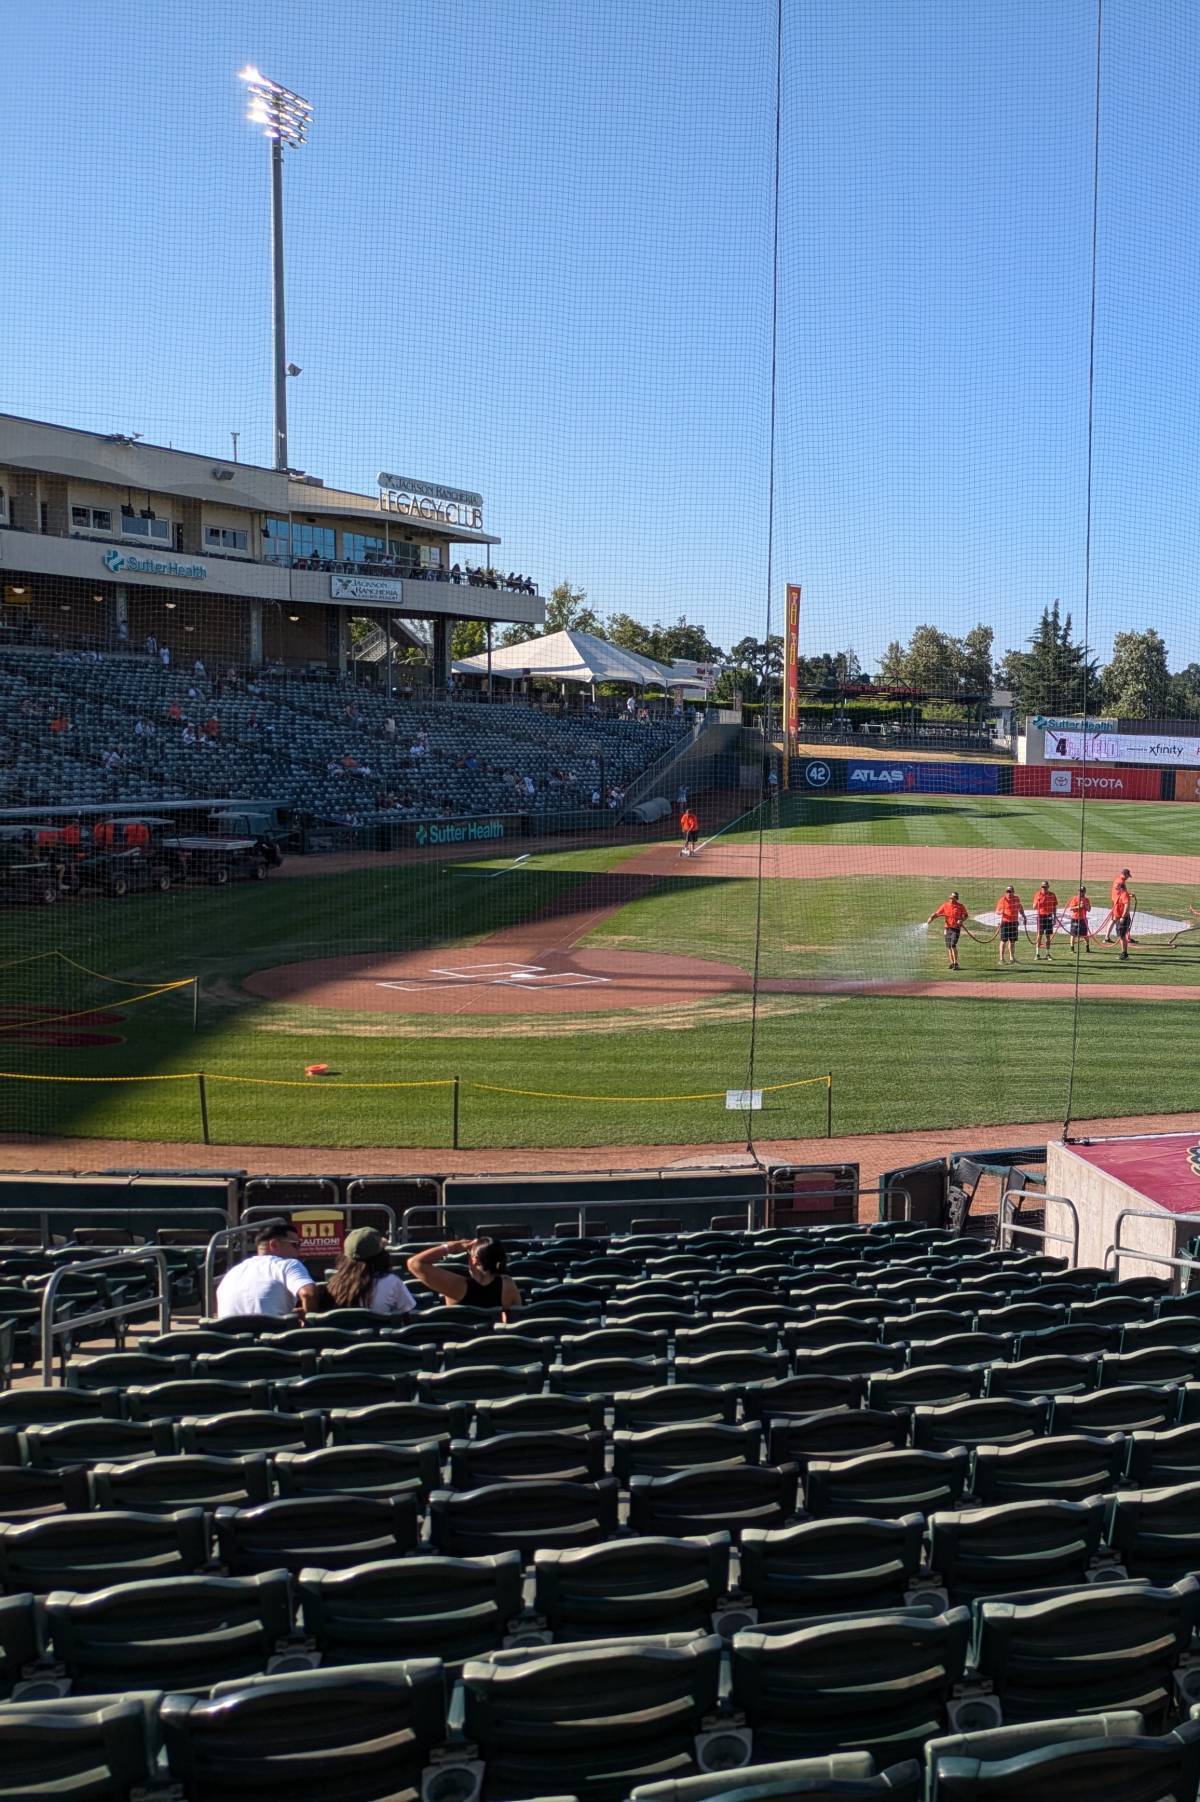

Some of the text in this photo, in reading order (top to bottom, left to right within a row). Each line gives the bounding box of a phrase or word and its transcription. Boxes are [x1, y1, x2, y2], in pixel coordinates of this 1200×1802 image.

[396, 479, 434, 495] JACKSON
[380, 488, 483, 529] LEGACY CLUB
[127, 556, 207, 579] Sutter Health
[1048, 719, 1113, 731] Sutter Health
[1149, 743, 1184, 757] xfinity
[810, 768, 825, 780] 42
[851, 769, 904, 783] ATLAS
[1075, 777, 1123, 788] TOYOTA
[430, 820, 504, 843] Sutter Health
